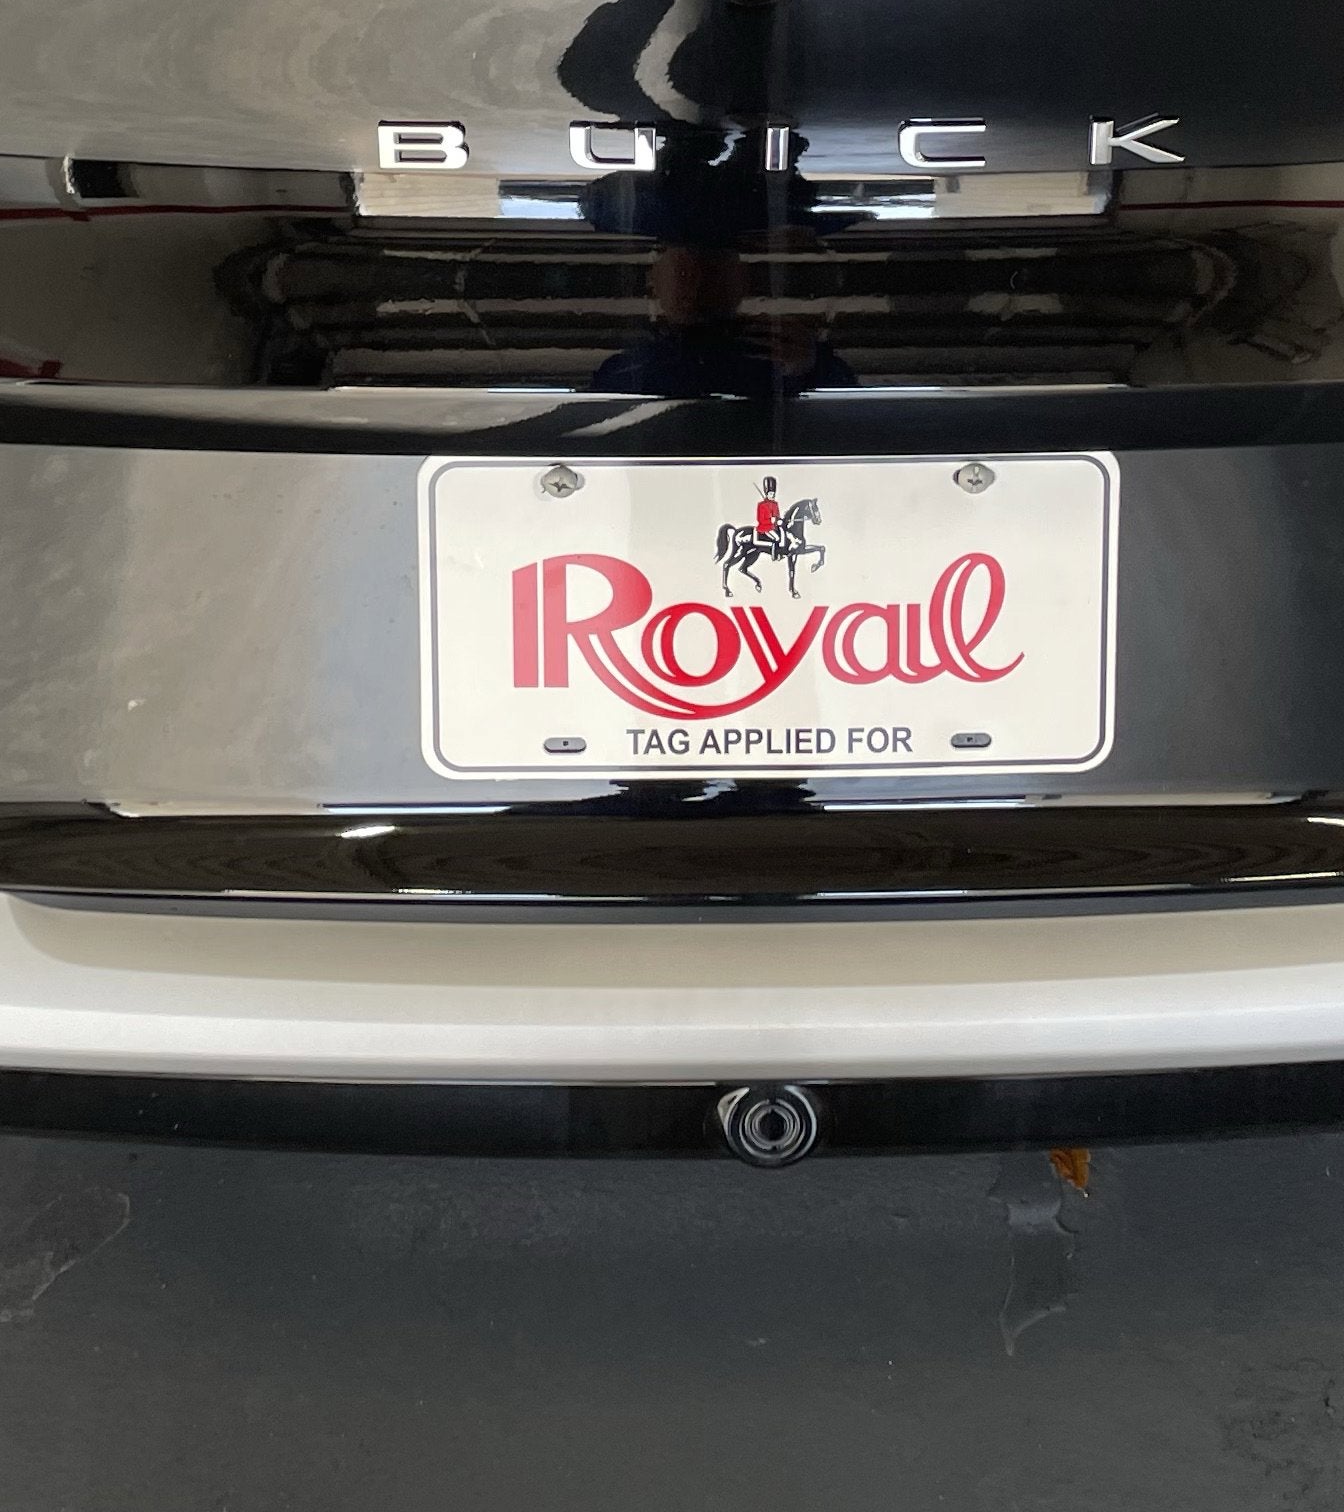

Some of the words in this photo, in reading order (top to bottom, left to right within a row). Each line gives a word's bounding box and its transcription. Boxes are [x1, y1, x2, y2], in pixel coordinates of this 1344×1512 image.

[377, 114, 1186, 171] BUICK
[511, 552, 1026, 721] Royal
[625, 728, 690, 756] TAG
[699, 728, 835, 755] APPLIED
[846, 726, 913, 754] FOR
